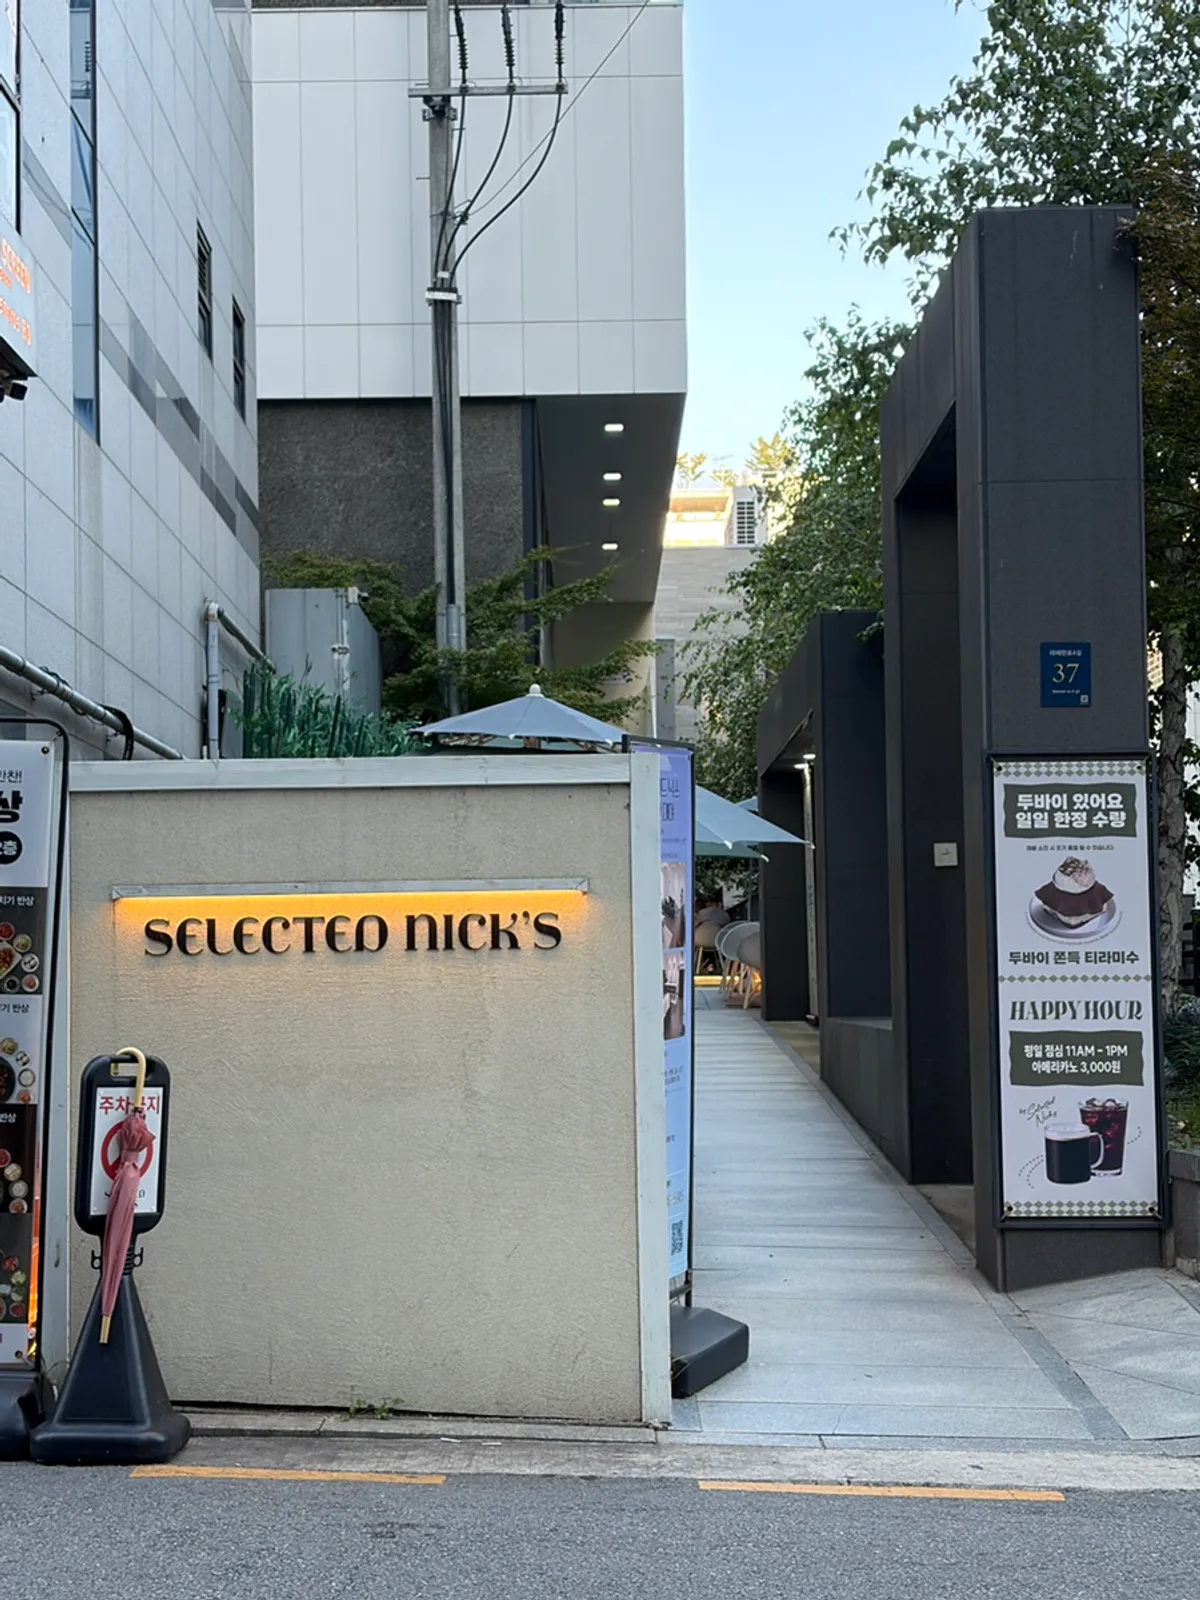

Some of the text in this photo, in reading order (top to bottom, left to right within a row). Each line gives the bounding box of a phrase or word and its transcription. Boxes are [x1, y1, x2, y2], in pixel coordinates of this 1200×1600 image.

[1051, 662, 1080, 684] 37
[1016, 792, 1124, 811] 두바이 있어요
[1015, 811, 1127, 829] 일일 한정 수량
[17, 895, 35, 907] 반상
[144, 910, 562, 957] SELECTED NICK'S
[1008, 950, 1140, 965] 두바이 쫀득 티라미수
[12, 1003, 29, 1014] 반상
[1009, 1000, 1144, 1021] HAPPY HOUR
[1024, 1045, 1043, 1058] 평일
[1044, 1044, 1064, 1058] 점심
[1065, 1045, 1095, 1057] 11AM
[1105, 1045, 1128, 1057] 1PM
[1032, 1060, 1121, 1075] 아메리카노 3,000원
